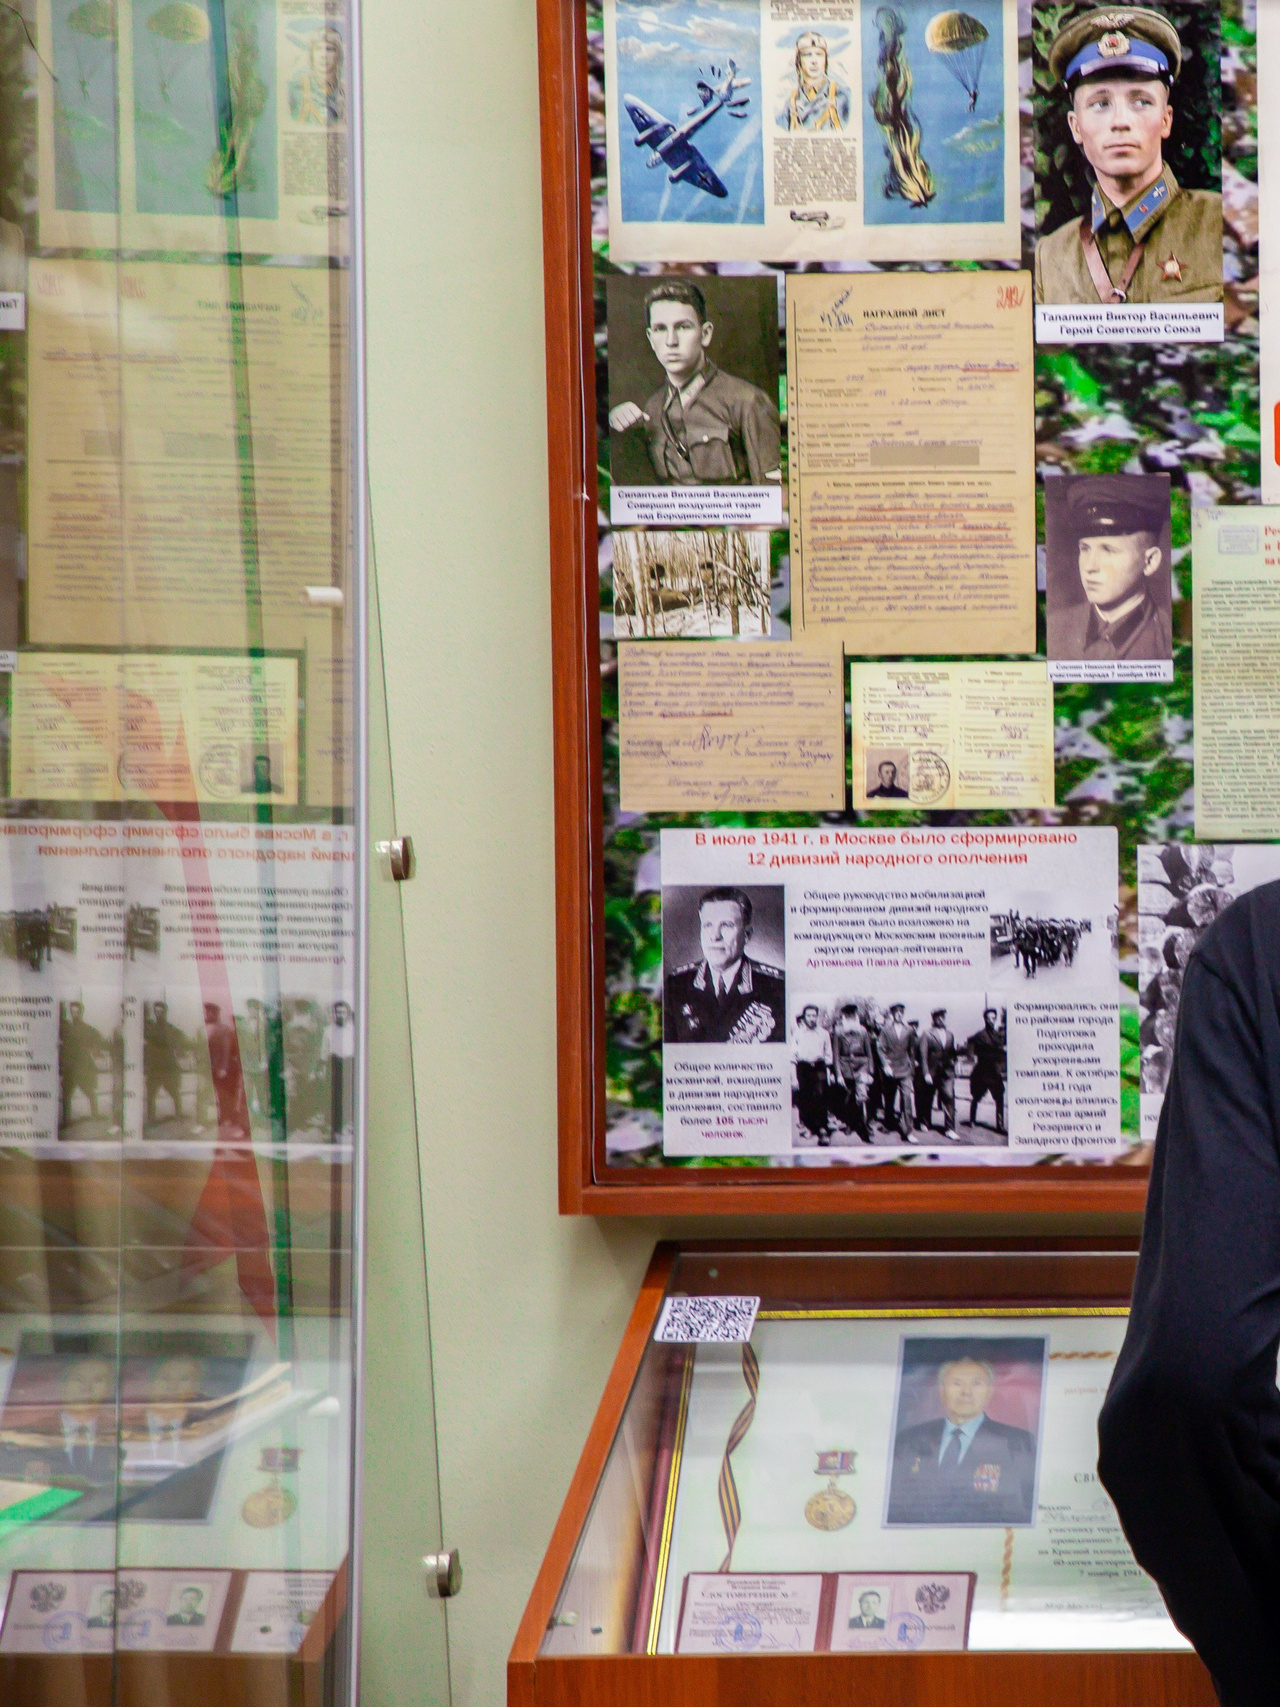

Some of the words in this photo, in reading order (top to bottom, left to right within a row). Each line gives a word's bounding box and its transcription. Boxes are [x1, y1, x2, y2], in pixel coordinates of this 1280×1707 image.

[863, 308, 918, 318] НАГРАДНОЙ
[921, 309, 945, 318] ЛИСТ
[1060, 326, 1093, 337] Герой
[1096, 325, 1161, 334] Советского
[1164, 324, 1201, 333] Союза
[1265, 557, 1275, 565] на
[695, 833, 706, 845] В
[712, 835, 756, 845] июле
[764, 832, 797, 845] 1941
[803, 835, 813, 845] г.
[819, 835, 829, 844] в
[835, 832, 896, 845] Москве
[900, 832, 946, 844] было
[950, 831, 1077, 847] сформировано
[749, 853, 765, 866] 12
[769, 851, 840, 869] дивизий
[845, 855, 933, 869] народного
[938, 854, 1028, 865] ополчения
[1036, 1029, 1096, 1040] Подготовка
[1038, 1043, 1094, 1053] проходила
[673, 1062, 711, 1073] Общее
[713, 1063, 773, 1072] количество
[1042, 1082, 1065, 1093] 1941
[1068, 1084, 1092, 1093] года
